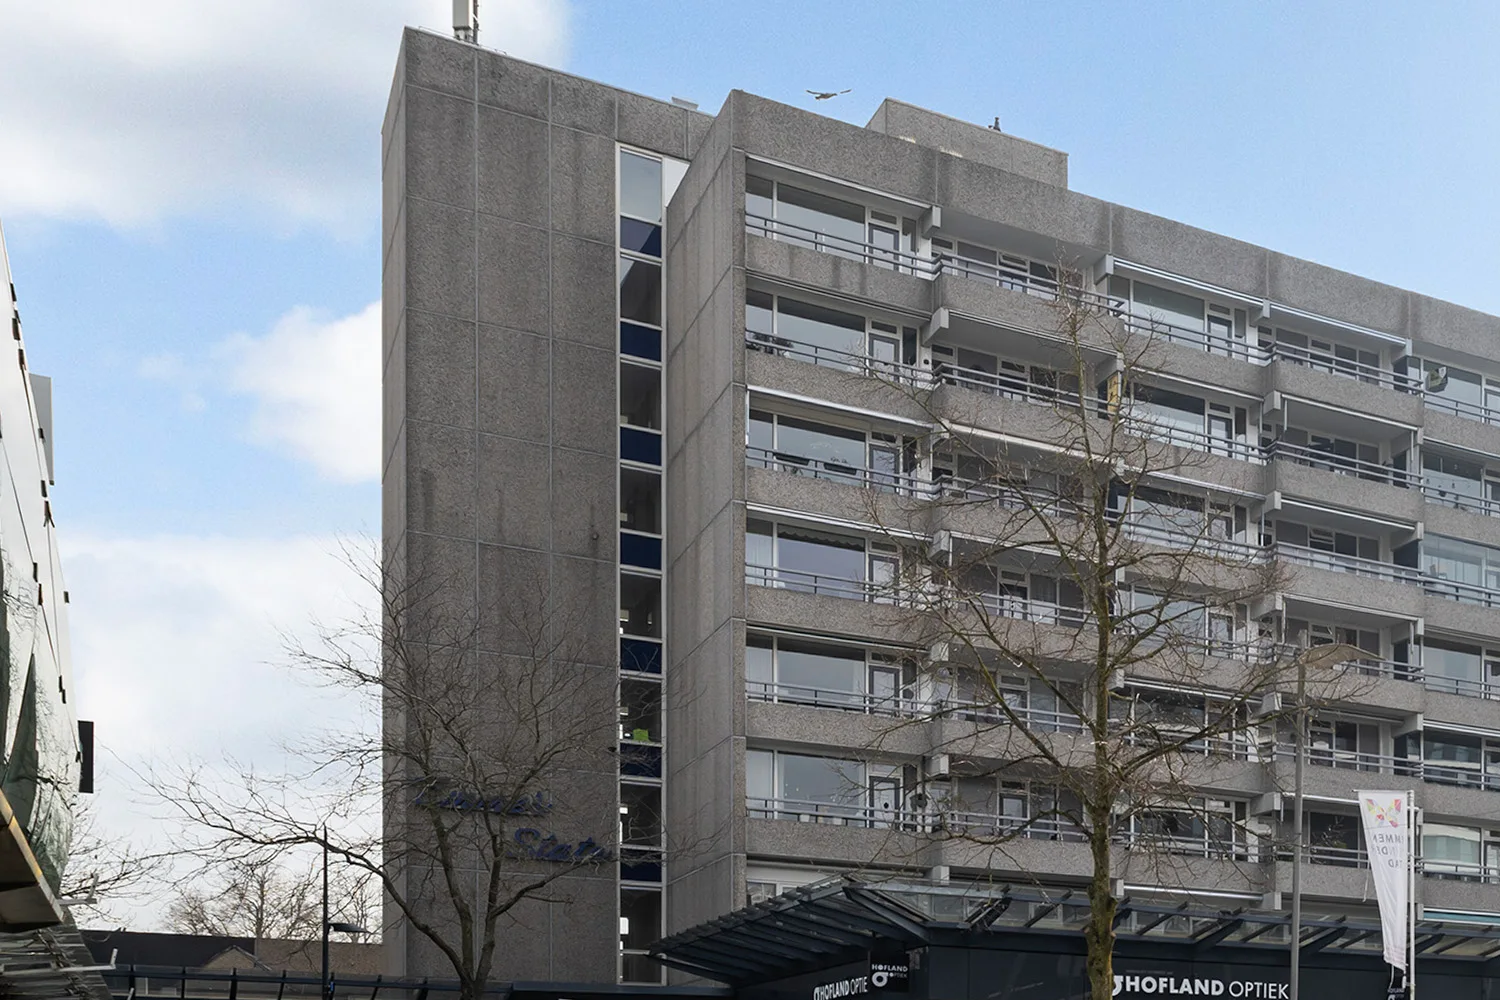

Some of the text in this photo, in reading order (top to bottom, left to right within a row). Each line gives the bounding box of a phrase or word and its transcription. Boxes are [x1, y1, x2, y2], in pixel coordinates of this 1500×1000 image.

[871, 963, 908, 972] HOFLAND
[850, 976, 868, 995] OPTIE
[1125, 975, 1290, 1000] HOFLAND OPTIEK
